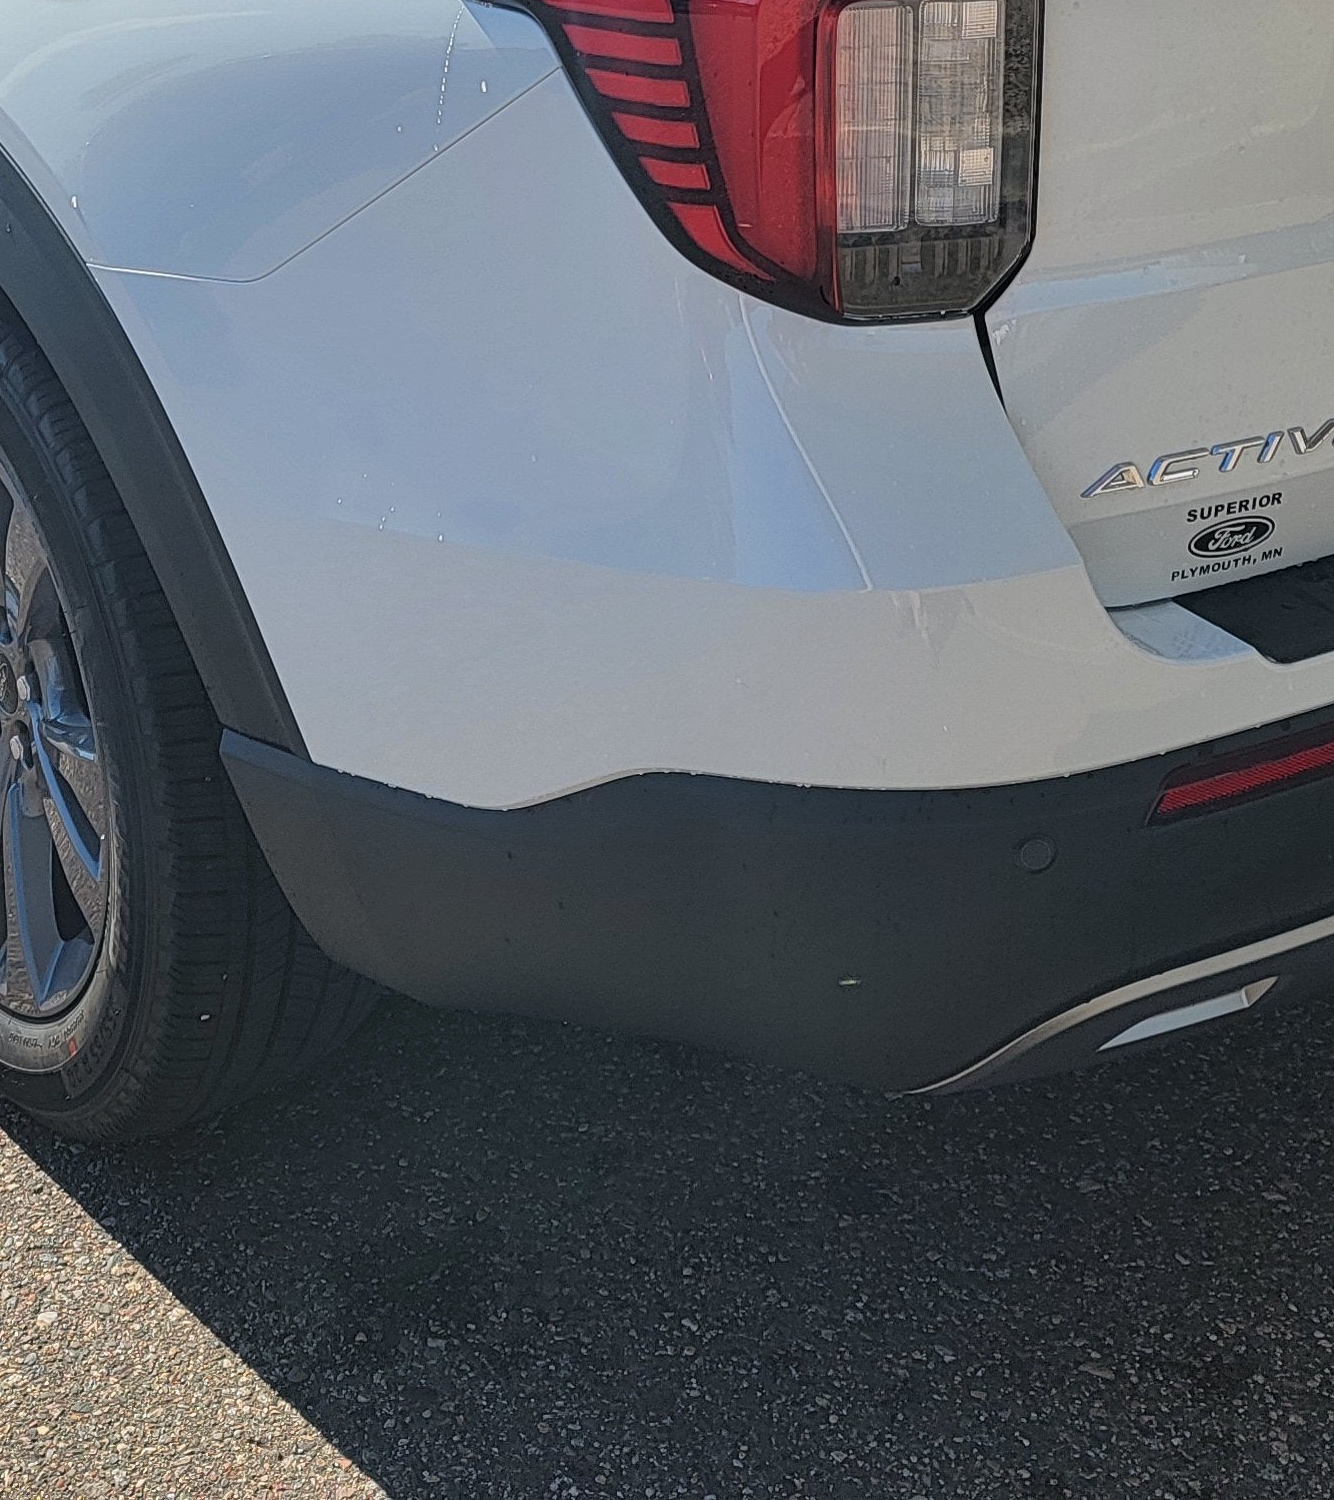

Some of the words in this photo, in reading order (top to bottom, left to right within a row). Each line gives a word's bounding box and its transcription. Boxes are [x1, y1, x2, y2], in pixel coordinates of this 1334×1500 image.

[1186, 492, 1283, 523] SUPERIOR
[1208, 523, 1255, 550] Ford
[1171, 556, 1258, 582] PLYMOUTH,
[1261, 546, 1284, 563] MN
